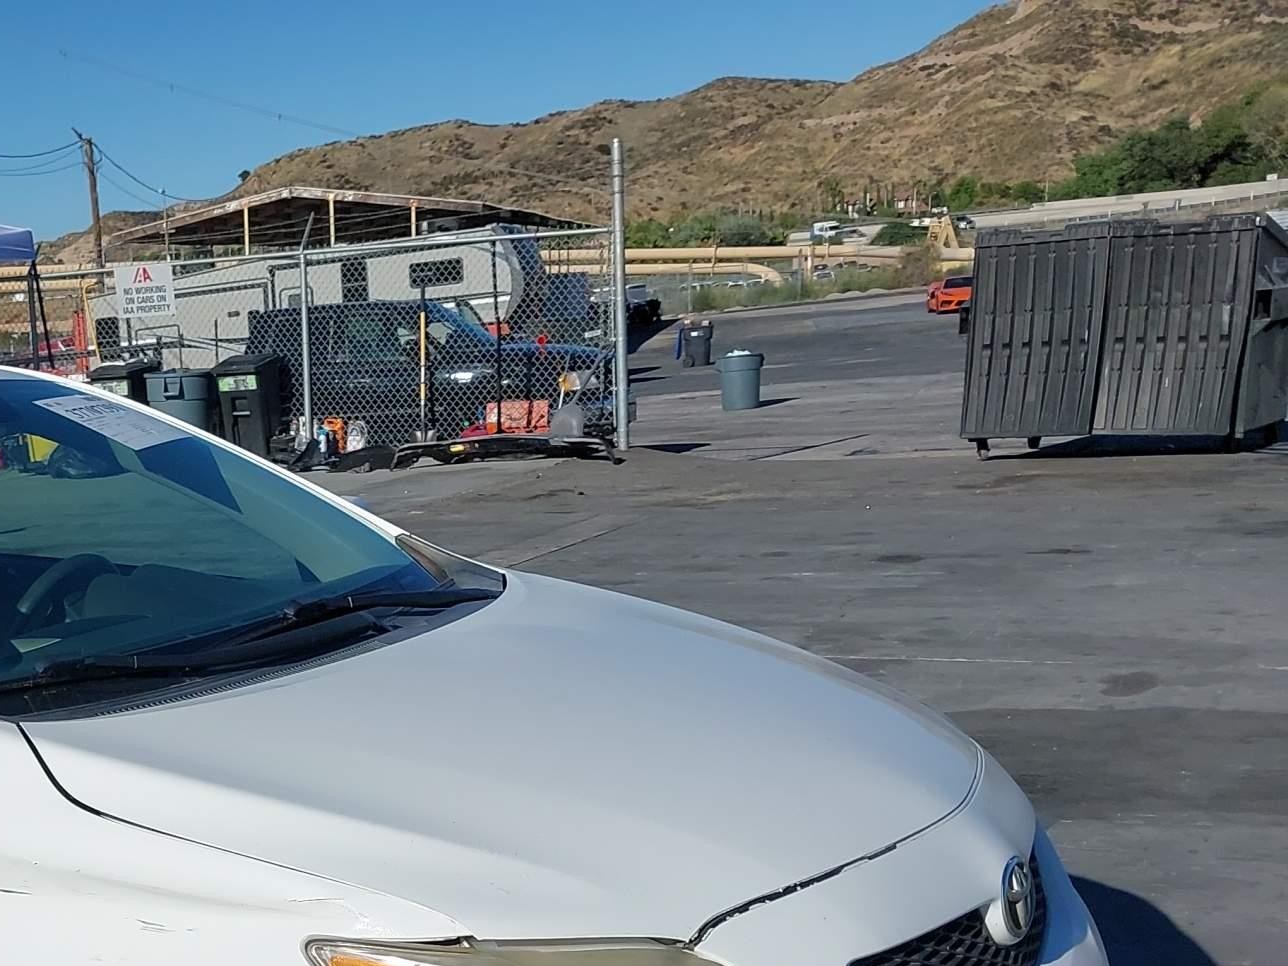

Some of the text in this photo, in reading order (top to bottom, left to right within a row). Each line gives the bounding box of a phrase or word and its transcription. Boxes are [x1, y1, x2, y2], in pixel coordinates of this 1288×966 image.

[135, 285, 166, 294] WORKING
[125, 297, 135, 305] ON
[137, 296, 155, 304] CARS
[137, 304, 170, 313] PROPERTY
